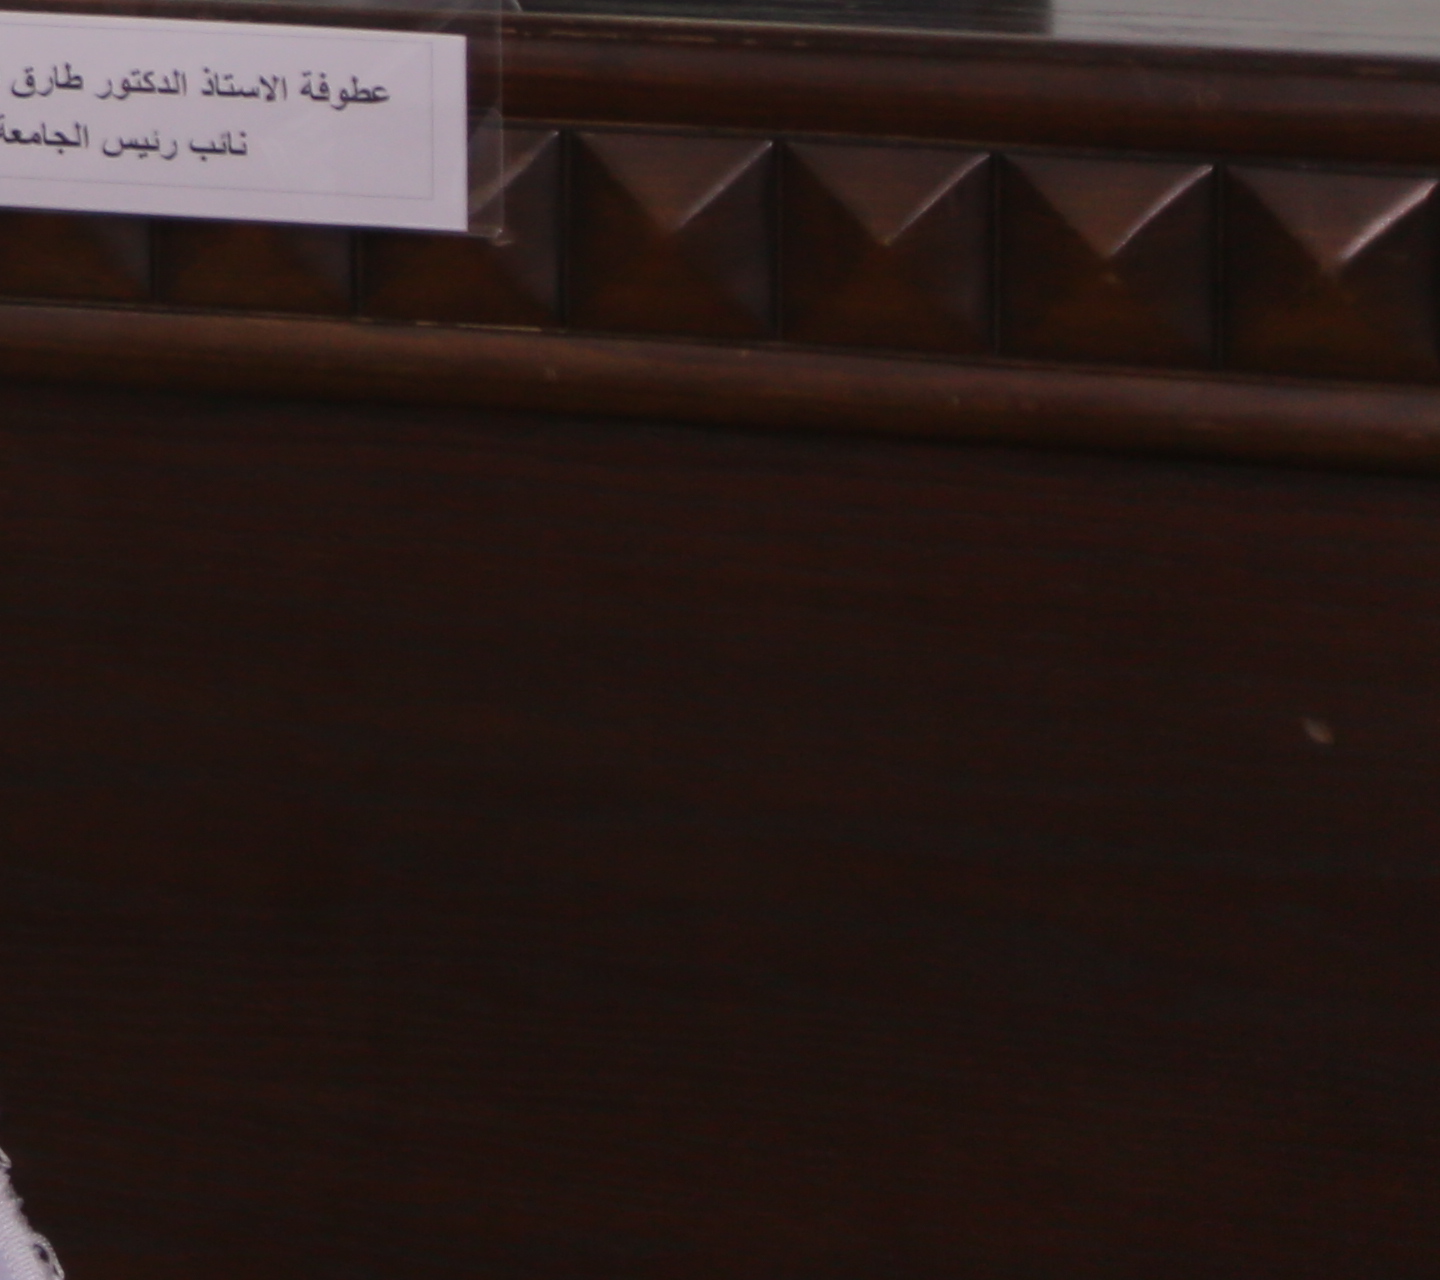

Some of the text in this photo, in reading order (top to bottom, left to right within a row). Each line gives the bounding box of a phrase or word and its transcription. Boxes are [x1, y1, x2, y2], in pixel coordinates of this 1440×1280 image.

[10, 63, 84, 100] طارق
[97, 70, 188, 102] الدكتور
[201, 66, 288, 104] الاستاذ
[299, 70, 390, 112] عطوفة
[102, 136, 178, 162] رئيس
[189, 131, 248, 162] نائب
